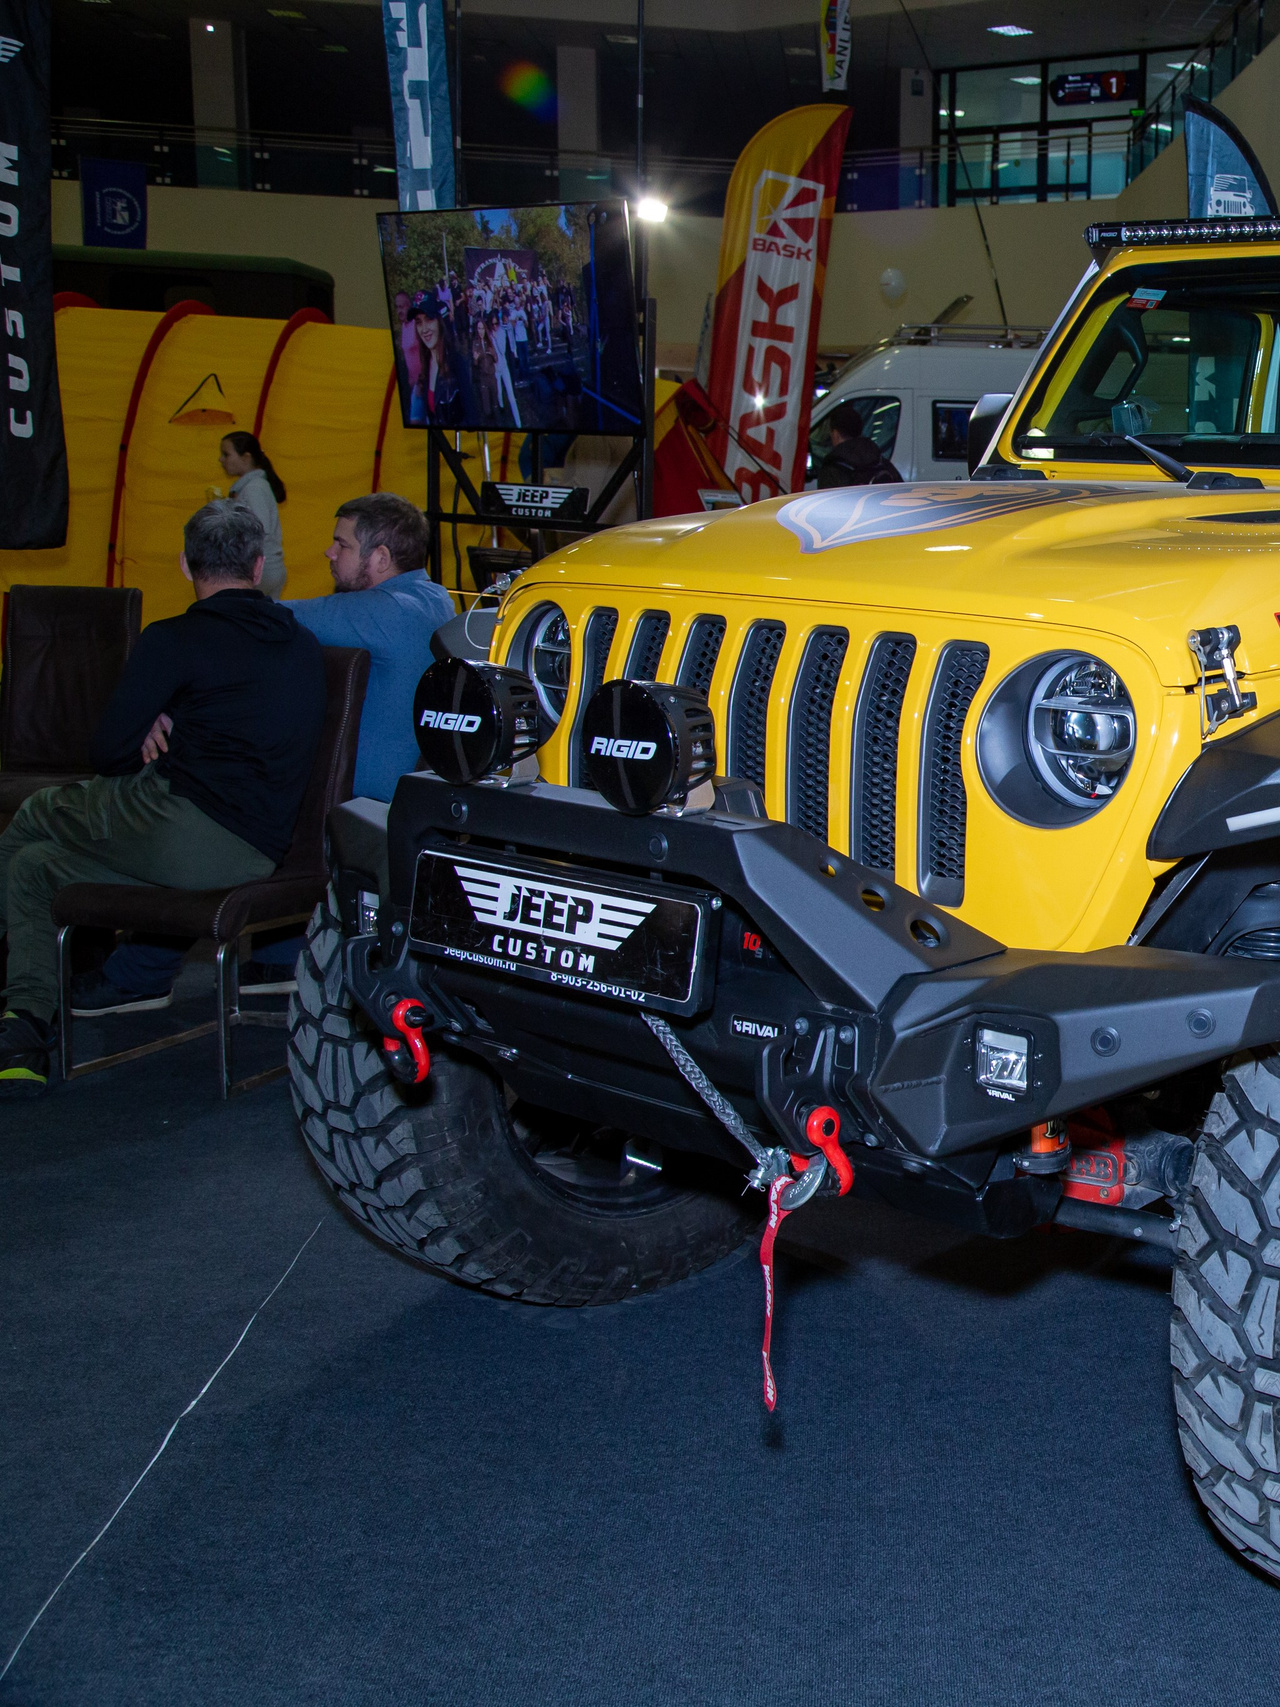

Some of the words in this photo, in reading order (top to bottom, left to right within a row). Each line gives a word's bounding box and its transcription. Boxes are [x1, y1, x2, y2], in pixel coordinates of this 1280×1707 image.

[1109, 77, 1117, 94] 1
[752, 236, 814, 262] BASK
[734, 274, 800, 504] BASK
[515, 488, 549, 504] JEEP
[511, 507, 552, 518] CUSTOM
[420, 709, 482, 733] RIGID
[590, 736, 657, 760] RIGID
[502, 884, 595, 935] JEEP
[743, 931, 762, 951] 10
[492, 934, 596, 974] CUSTOM
[991, 1089, 1016, 1102] RIVAL
[768, 1175, 793, 1229] WARN
